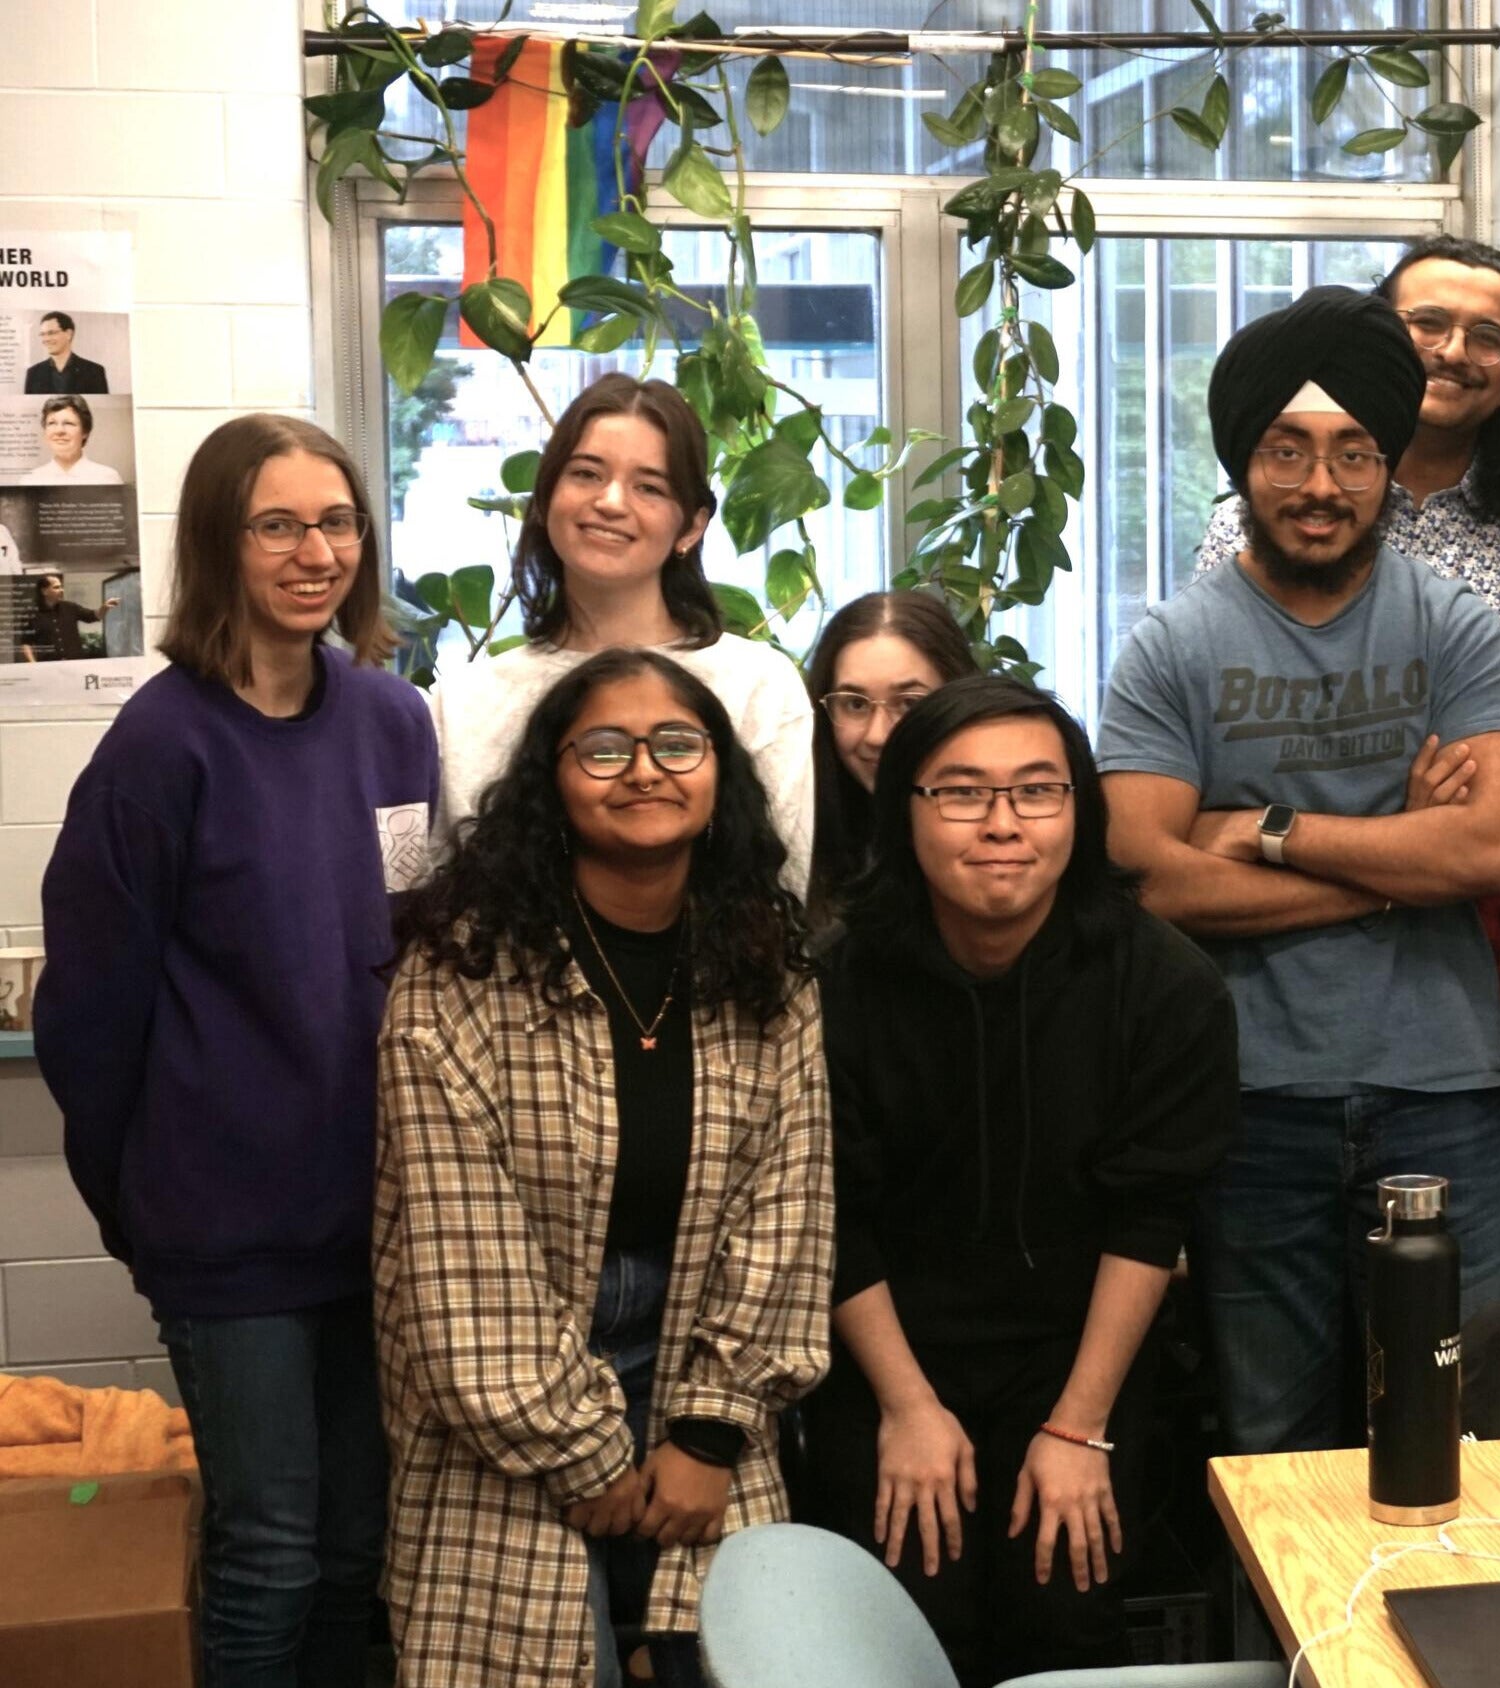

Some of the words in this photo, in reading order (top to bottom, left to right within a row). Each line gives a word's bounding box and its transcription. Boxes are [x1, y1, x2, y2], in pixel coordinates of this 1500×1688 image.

[0, 270, 69, 288] WORLD
[1214, 657, 1429, 724] BUFFALO
[1279, 736, 1333, 760] DAVID
[1339, 725, 1407, 757] BITTON
